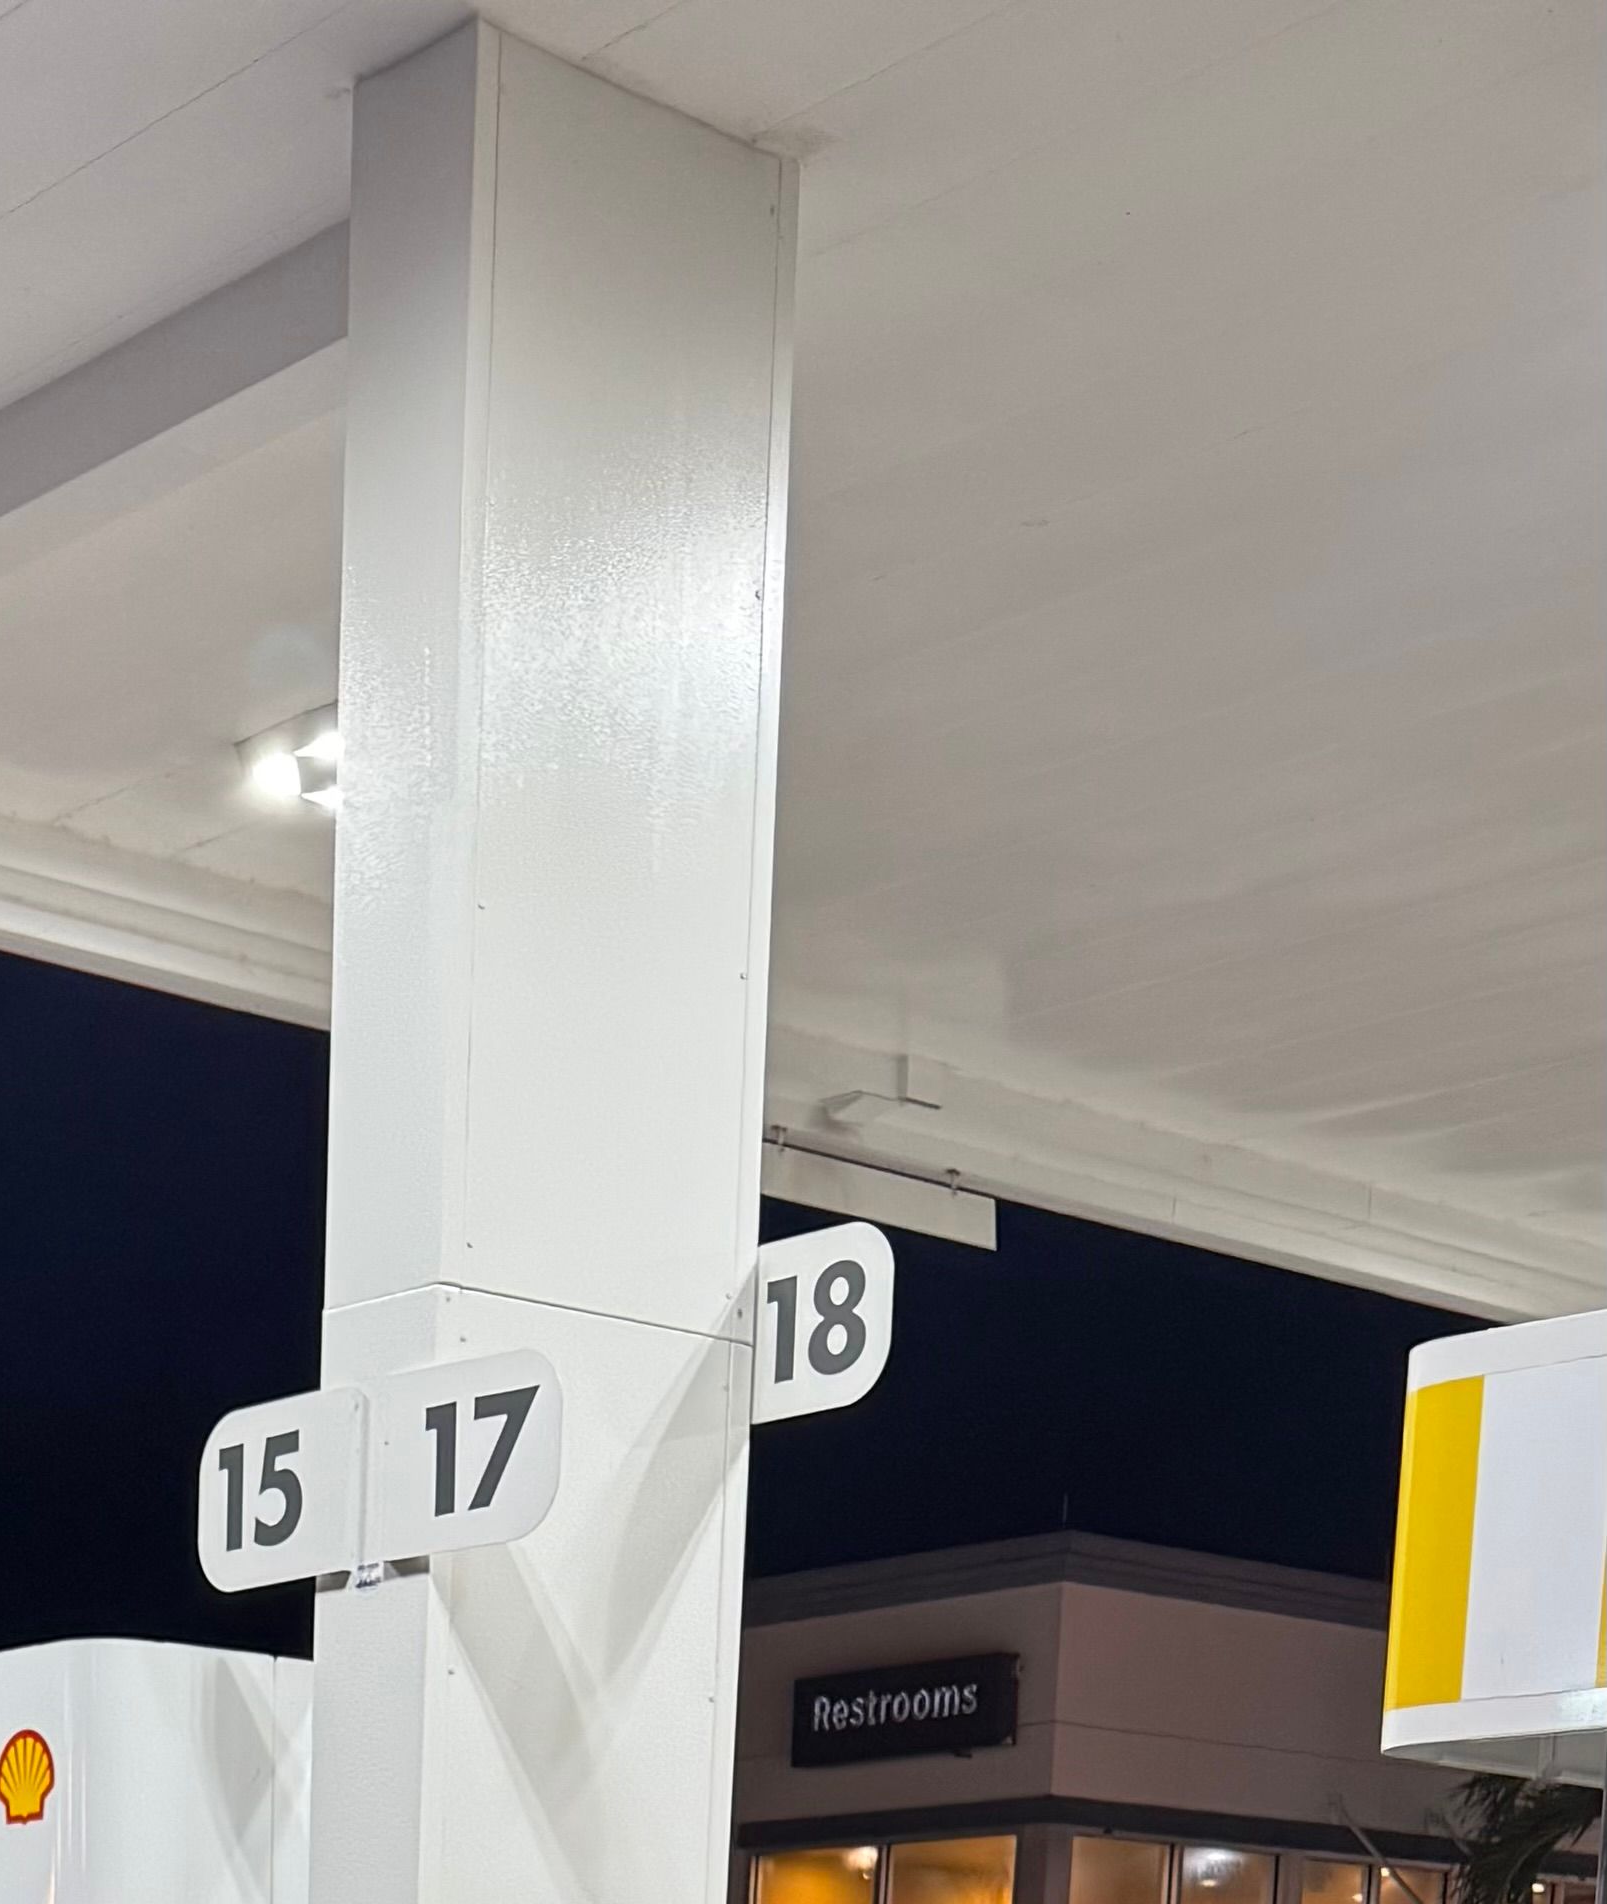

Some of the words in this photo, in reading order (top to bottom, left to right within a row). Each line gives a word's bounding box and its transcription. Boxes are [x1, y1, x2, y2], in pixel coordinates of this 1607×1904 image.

[766, 1259, 868, 1386] 18
[217, 1429, 304, 1552] 15
[424, 1384, 541, 1518] 17
[813, 1683, 979, 1733] Restrooms
